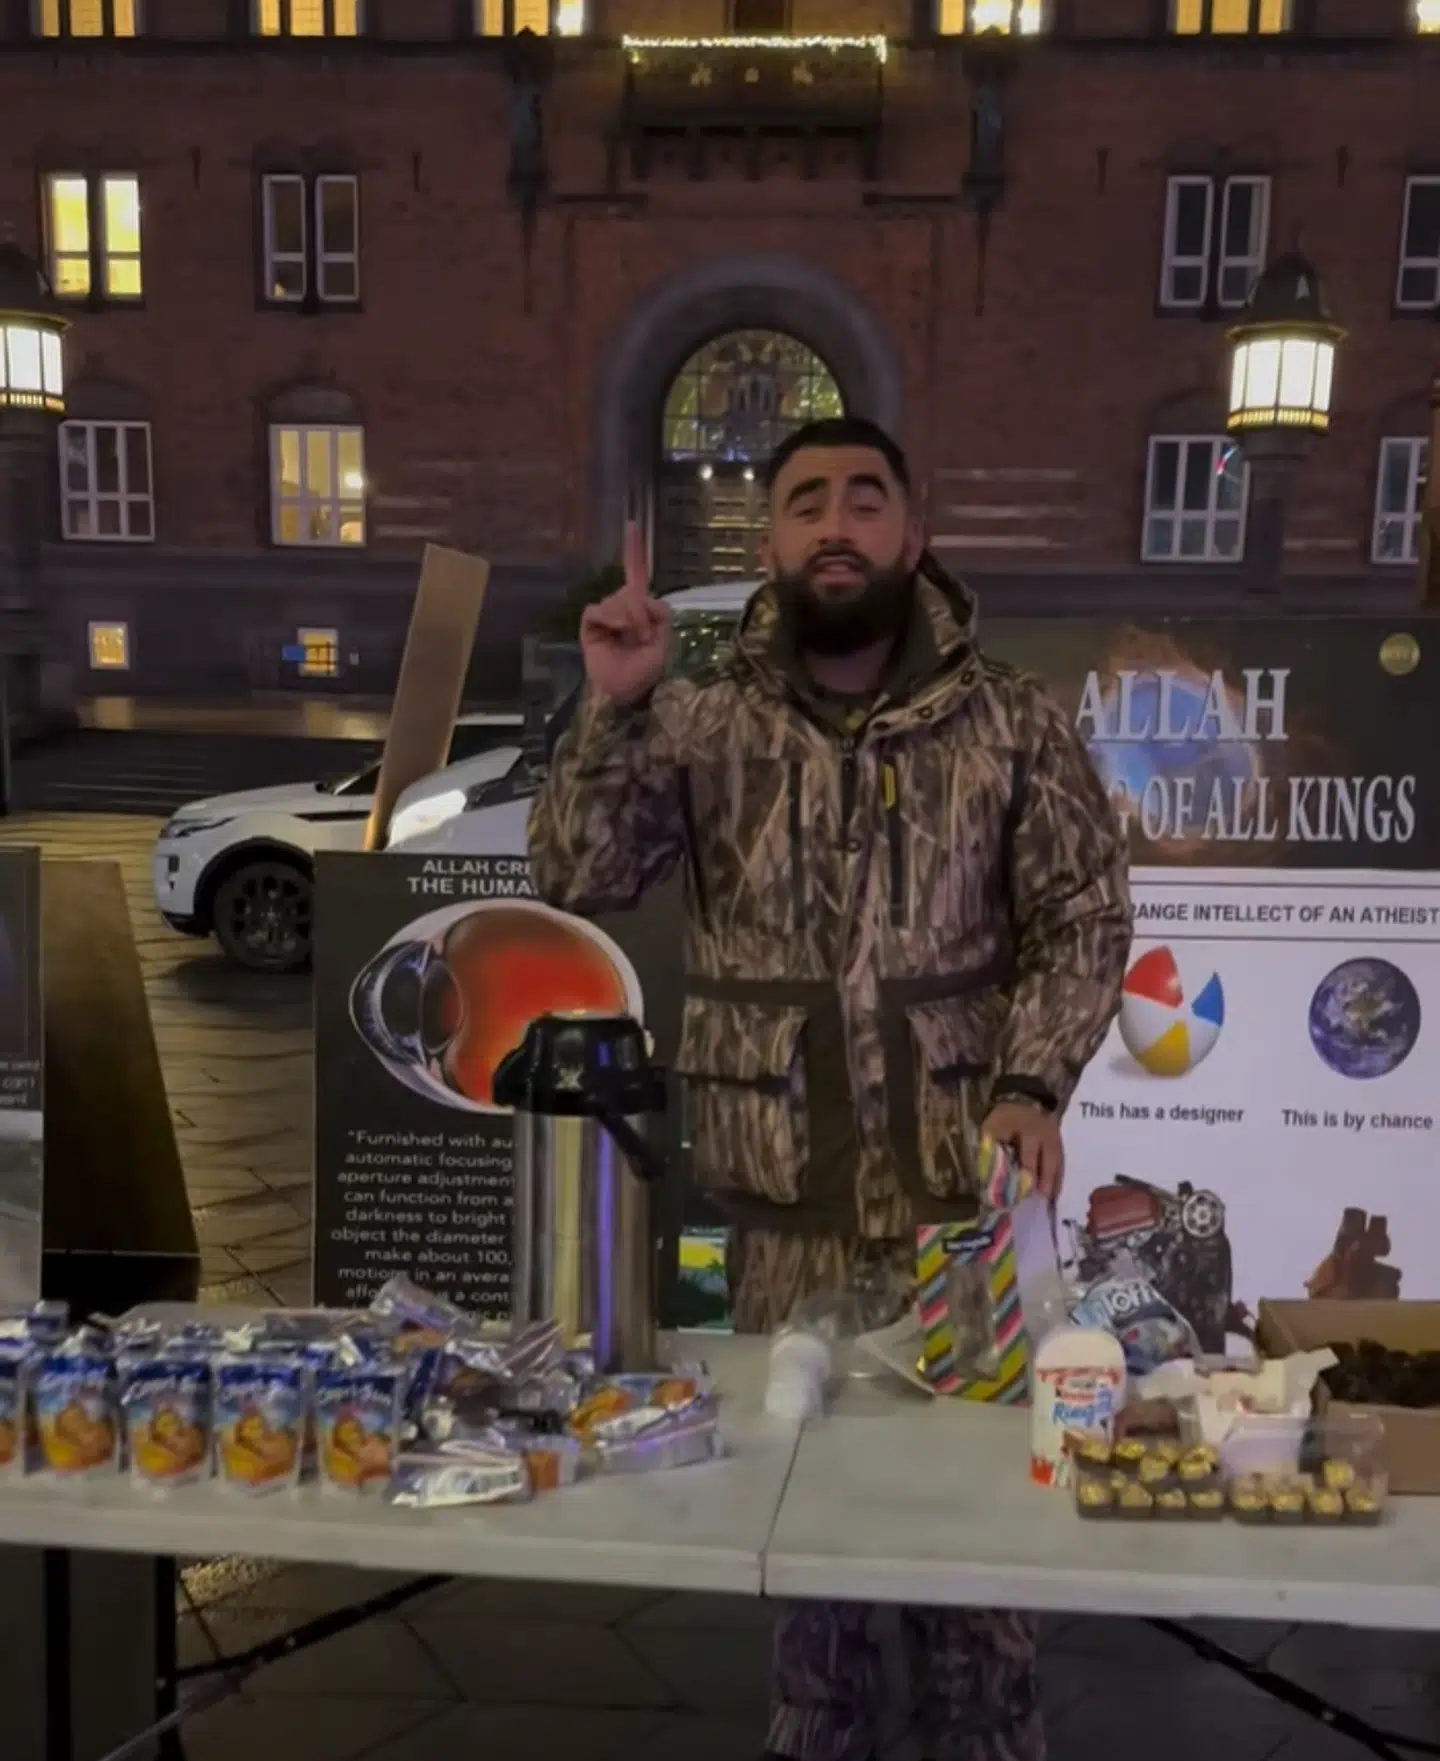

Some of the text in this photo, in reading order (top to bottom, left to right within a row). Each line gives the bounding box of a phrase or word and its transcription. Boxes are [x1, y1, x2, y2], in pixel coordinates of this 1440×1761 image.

[1075, 668, 1291, 741] ALLAH
[1141, 775, 1196, 841] OF
[1200, 776, 1279, 842] ALL
[1287, 774, 1417, 843] KINGS
[422, 859, 490, 874] ALLAH
[406, 876, 539, 896] THE HUMA
[1193, 904, 1294, 923] INTELLECT
[1299, 905, 1323, 923] OF
[1329, 905, 1355, 924] AN
[1360, 906, 1440, 925] ATHEIST
[1079, 1102, 1245, 1126] This has a designer
[1282, 1109, 1433, 1131] This is by chance
[449, 1134, 485, 1148] with
[345, 1152, 513, 1171] automatic focusing
[336, 1171, 412, 1188] aperture
[343, 1191, 374, 1203] can
[379, 1189, 451, 1205] function
[456, 1190, 498, 1206] from
[345, 1208, 506, 1228] darkness to bright
[330, 1226, 505, 1246] object the diameter
[364, 1249, 413, 1262] make
[417, 1248, 470, 1264] about
[414, 1267, 431, 1280] in
[435, 1270, 457, 1282] an
